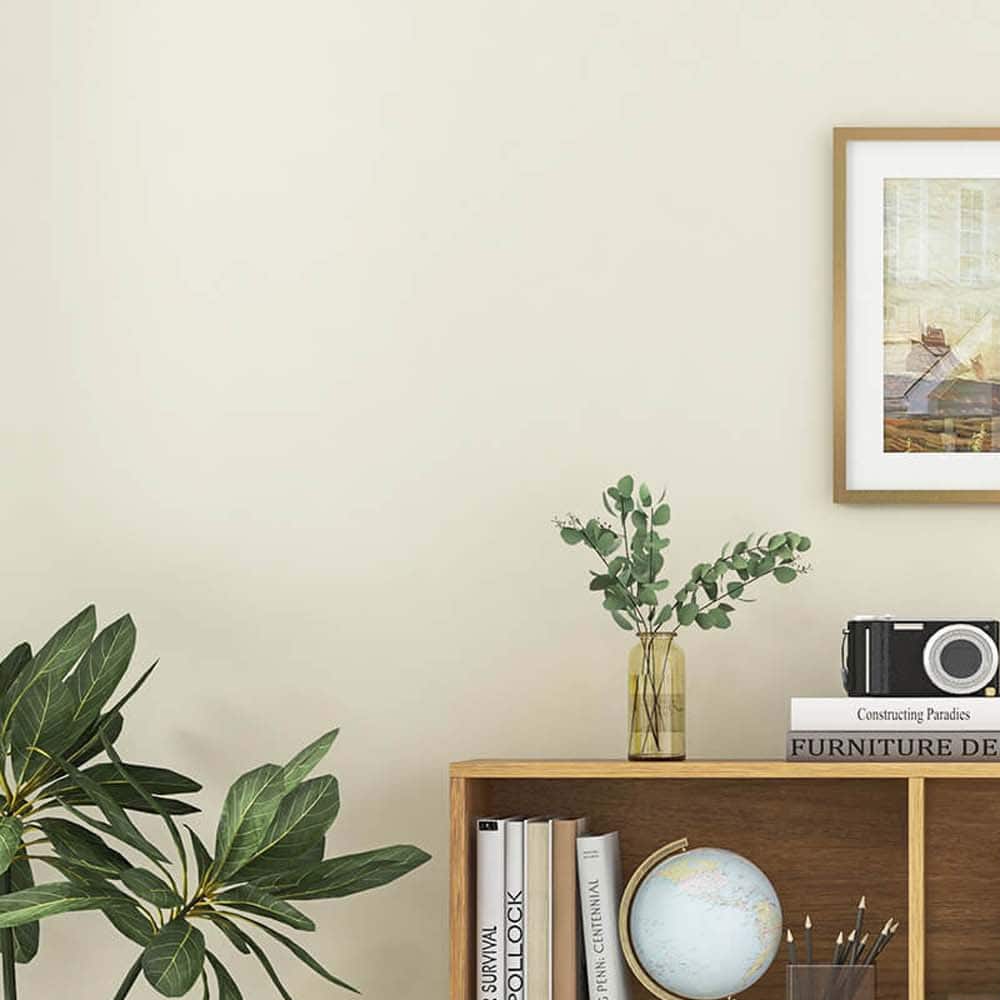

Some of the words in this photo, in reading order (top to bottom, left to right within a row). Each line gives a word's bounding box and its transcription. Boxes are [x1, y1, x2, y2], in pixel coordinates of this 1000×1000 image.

[857, 707, 924, 724] Constructing
[926, 707, 971, 721] Paradies
[791, 738, 952, 756] FURNITURE
[588, 879, 605, 953] CENTENNIAL
[481, 925, 497, 993] SURVIVAL
[595, 957, 608, 992] PENN:
